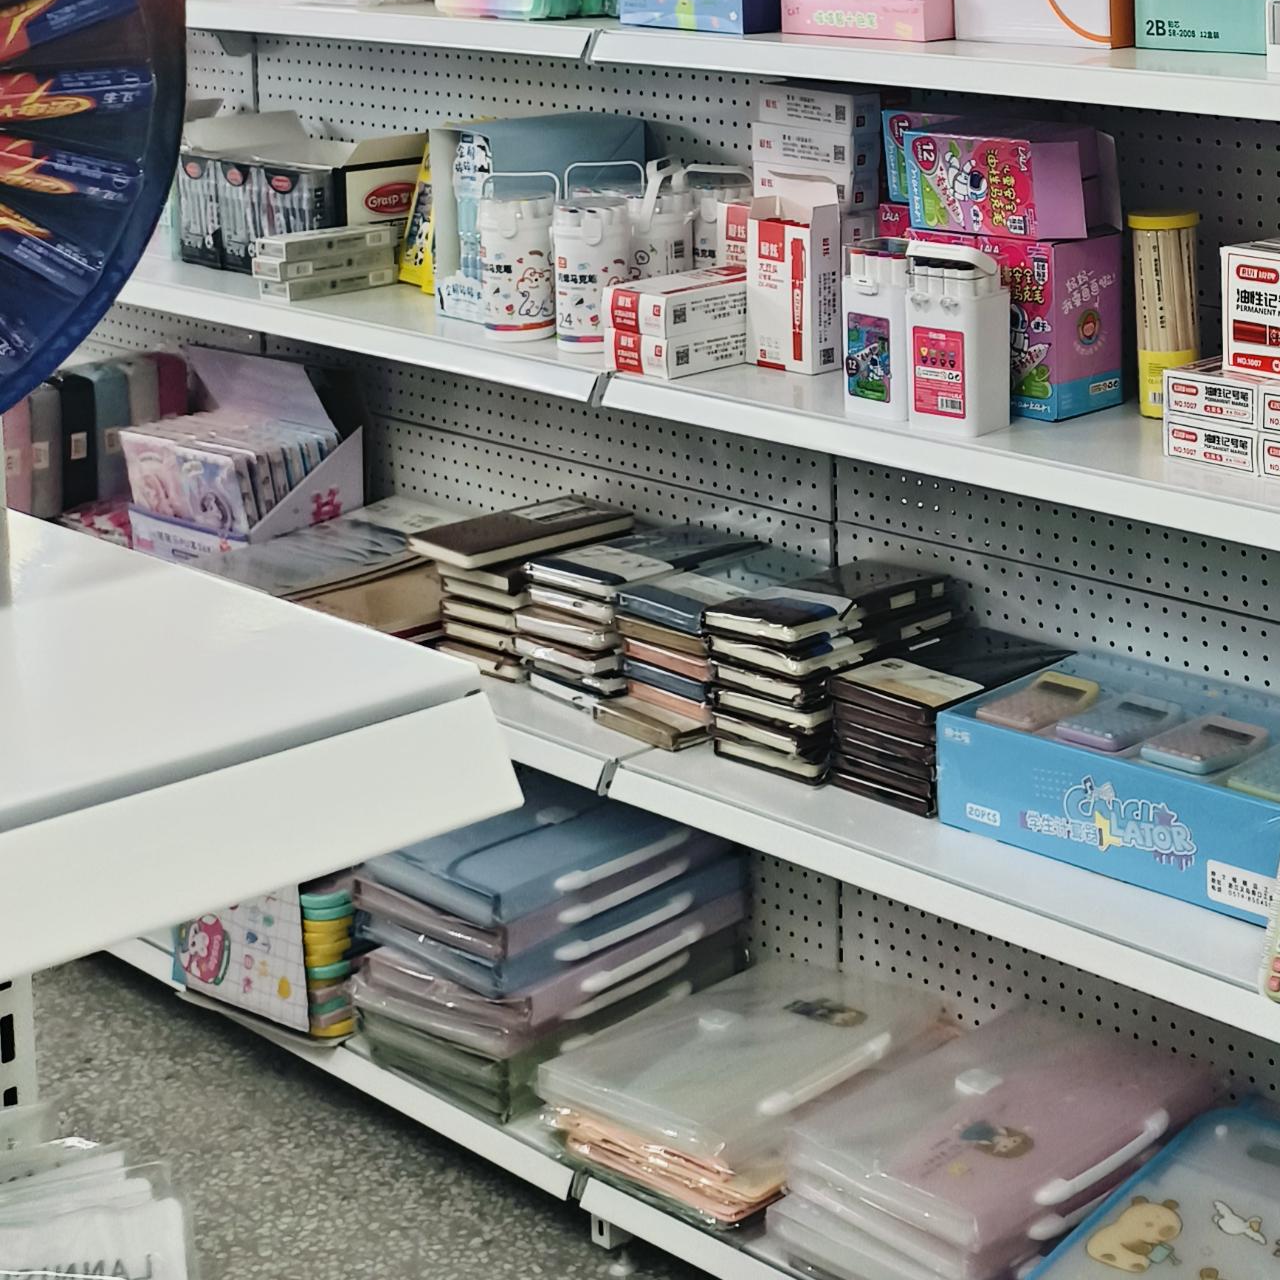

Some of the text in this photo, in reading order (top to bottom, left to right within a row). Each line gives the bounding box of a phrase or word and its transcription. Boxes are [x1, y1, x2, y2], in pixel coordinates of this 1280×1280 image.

[1146, 20, 1167, 37] 2B
[922, 142, 935, 163] 12
[1017, 146, 1028, 172] LALA
[368, 194, 399, 208] Grasp
[1236, 303, 1276, 318] PERMANENT
[559, 312, 573, 327] 24
[848, 360, 857, 369] 12
[1236, 356, 1262, 368] NO.1007
[1205, 385, 1249, 402] 油性记号笔
[1174, 400, 1197, 410] NO.1007
[1204, 433, 1248, 450] 油性记号笔
[1174, 446, 1197, 456] NO.1007
[968, 806, 998, 825] 20PCS
